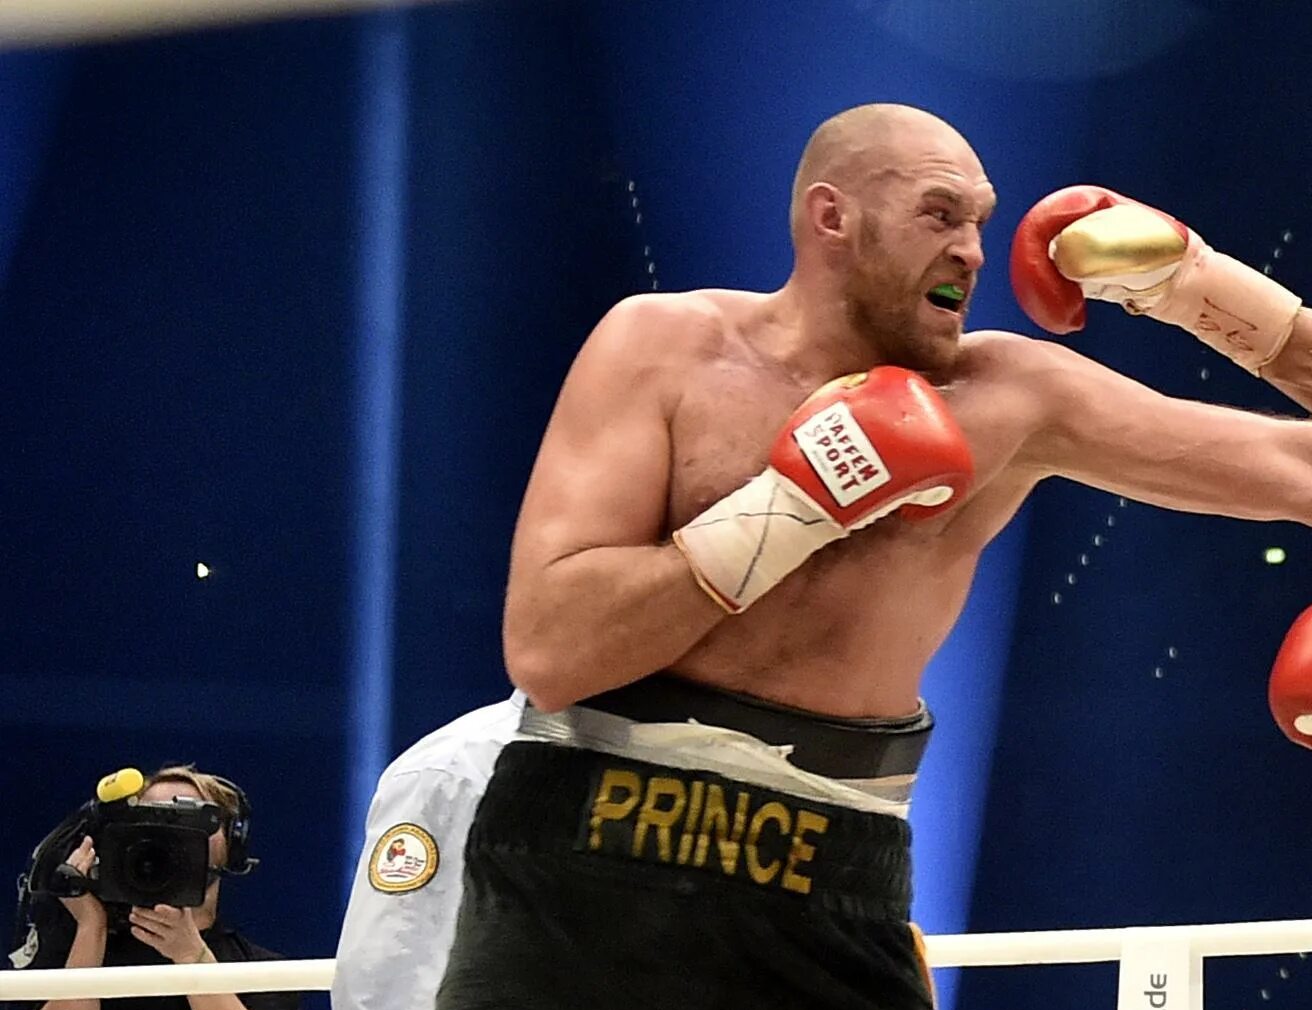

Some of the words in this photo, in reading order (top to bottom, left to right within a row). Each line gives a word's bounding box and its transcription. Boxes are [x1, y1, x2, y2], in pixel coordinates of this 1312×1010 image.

[804, 424, 861, 490] SPORT
[824, 412, 879, 481] PAFFEN
[589, 768, 829, 895] PRINCE
